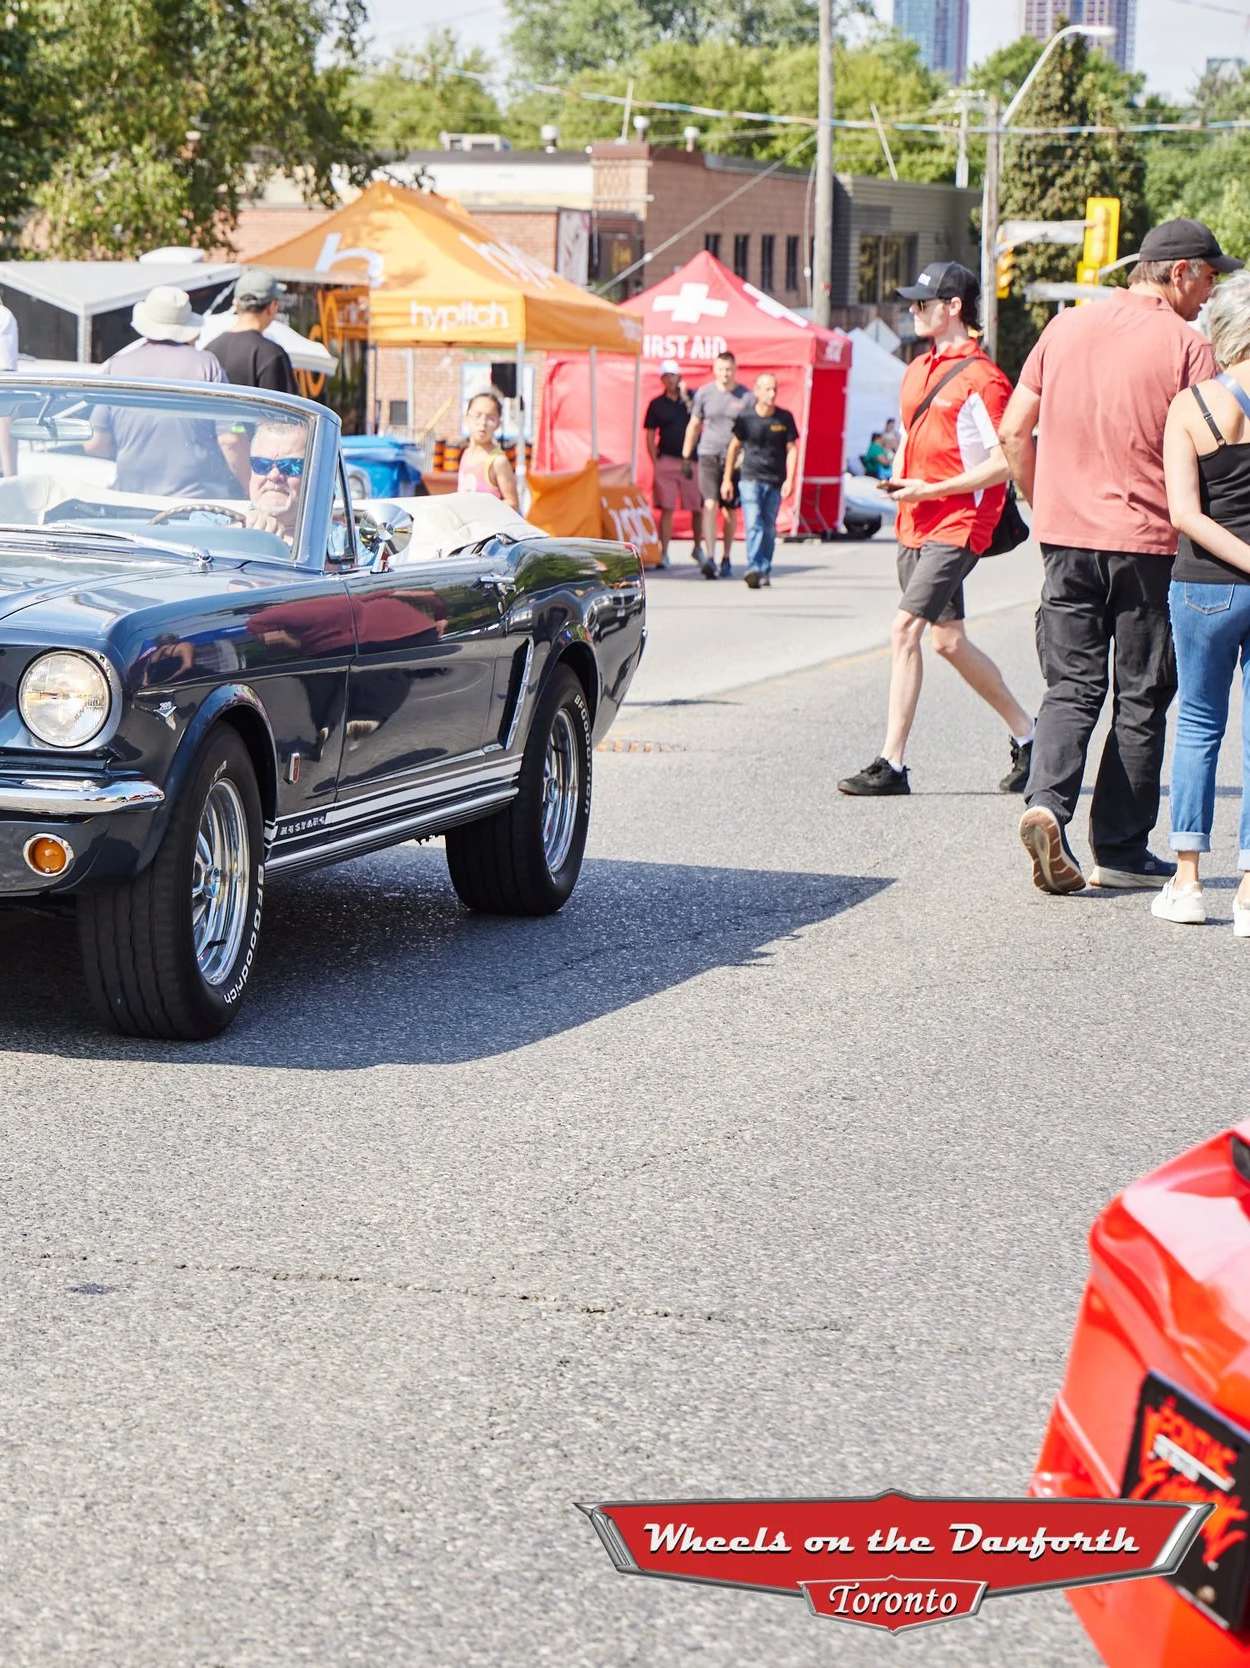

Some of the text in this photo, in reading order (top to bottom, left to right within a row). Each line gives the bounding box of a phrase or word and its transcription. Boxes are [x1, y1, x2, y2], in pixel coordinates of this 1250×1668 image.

[409, 299, 510, 333] hypitch
[643, 334, 728, 360] IRST AID
[223, 864, 264, 1005] BFGoodrich
